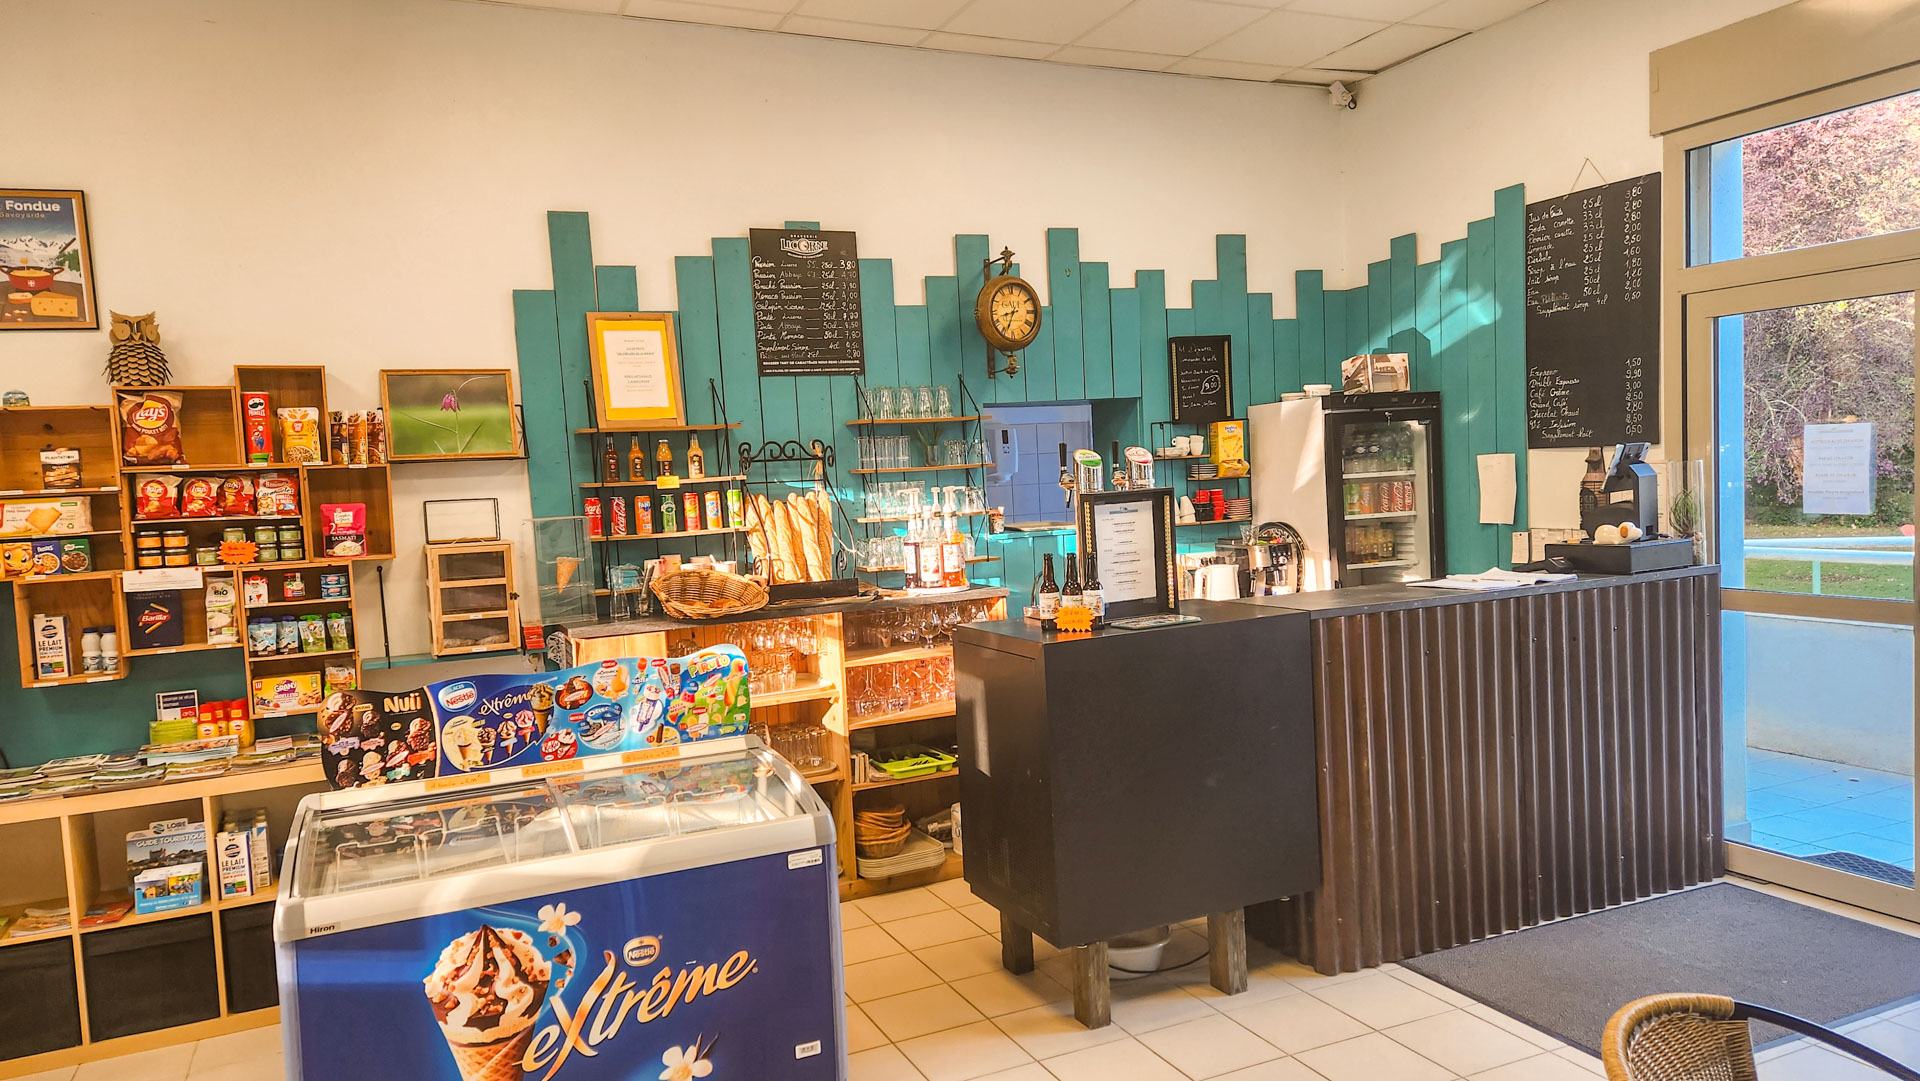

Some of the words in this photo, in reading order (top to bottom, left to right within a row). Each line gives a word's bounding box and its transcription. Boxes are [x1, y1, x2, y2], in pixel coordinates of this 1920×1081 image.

[5, 200, 61, 211] Fondue
[1529, 212, 1540, 223] Jus
[1542, 212, 1549, 220] de
[1528, 224, 1547, 234] Soda
[1624, 223, 1641, 234] 2,00
[780, 238, 829, 252] LICORNE
[1624, 235, 1642, 246] 2,50
[840, 260, 856, 270] 3,80
[754, 291, 779, 300] Monaco
[1624, 292, 1641, 303] 0,50
[780, 330, 805, 340] Monaco
[1626, 357, 1642, 369] 1,50
[136, 404, 166, 421] Lay's
[248, 409, 266, 417] PRINGLES
[1626, 424, 1643, 436] 0,50
[330, 522, 337, 535] 2
[142, 614, 168, 622] Barilla
[687, 654, 731, 679] PIRULO
[256, 682, 262, 690] LU
[274, 682, 297, 693] GRANY
[446, 691, 475, 708] Nestlé
[166, 822, 187, 830] LOIRE
[136, 838, 159, 848] GUIDE
[222, 860, 230, 868] LE
[231, 858, 245, 866] LAIT
[222, 864, 246, 872] PREMIUM
[310, 925, 335, 934] Hiron
[628, 946, 655, 960] Nestlé
